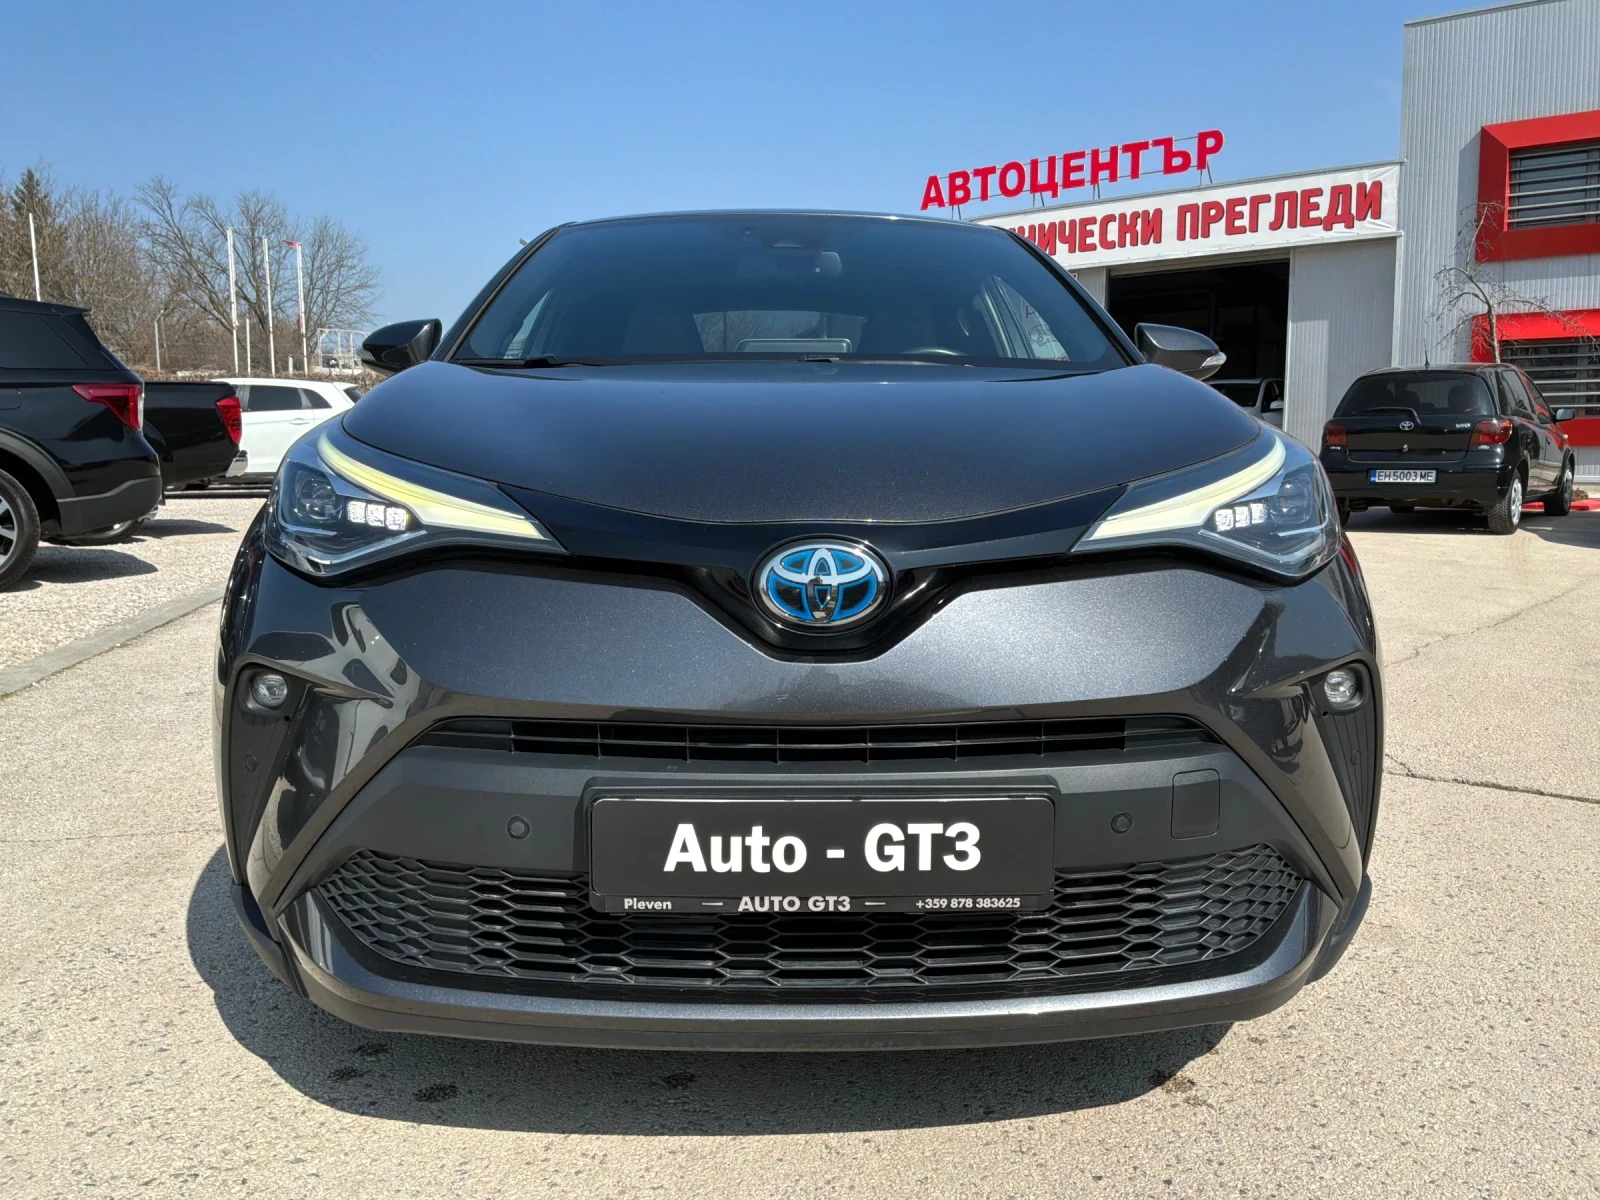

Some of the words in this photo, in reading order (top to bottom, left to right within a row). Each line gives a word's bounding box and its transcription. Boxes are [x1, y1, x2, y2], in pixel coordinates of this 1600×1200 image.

[920, 129, 1225, 211] АВТОЦЕНТЪР
[1009, 207, 1162, 256] ИЧЕСКИ
[1177, 180, 1383, 241] ПРЕГЛЕДИ
[663, 823, 808, 873] Auto
[864, 821, 982, 873] GT3
[623, 897, 672, 910] Pleven
[737, 895, 801, 912] AUTO
[807, 895, 851, 912] GT3
[915, 897, 949, 910] +359
[950, 897, 973, 910] 878
[975, 897, 1021, 910] 383625
